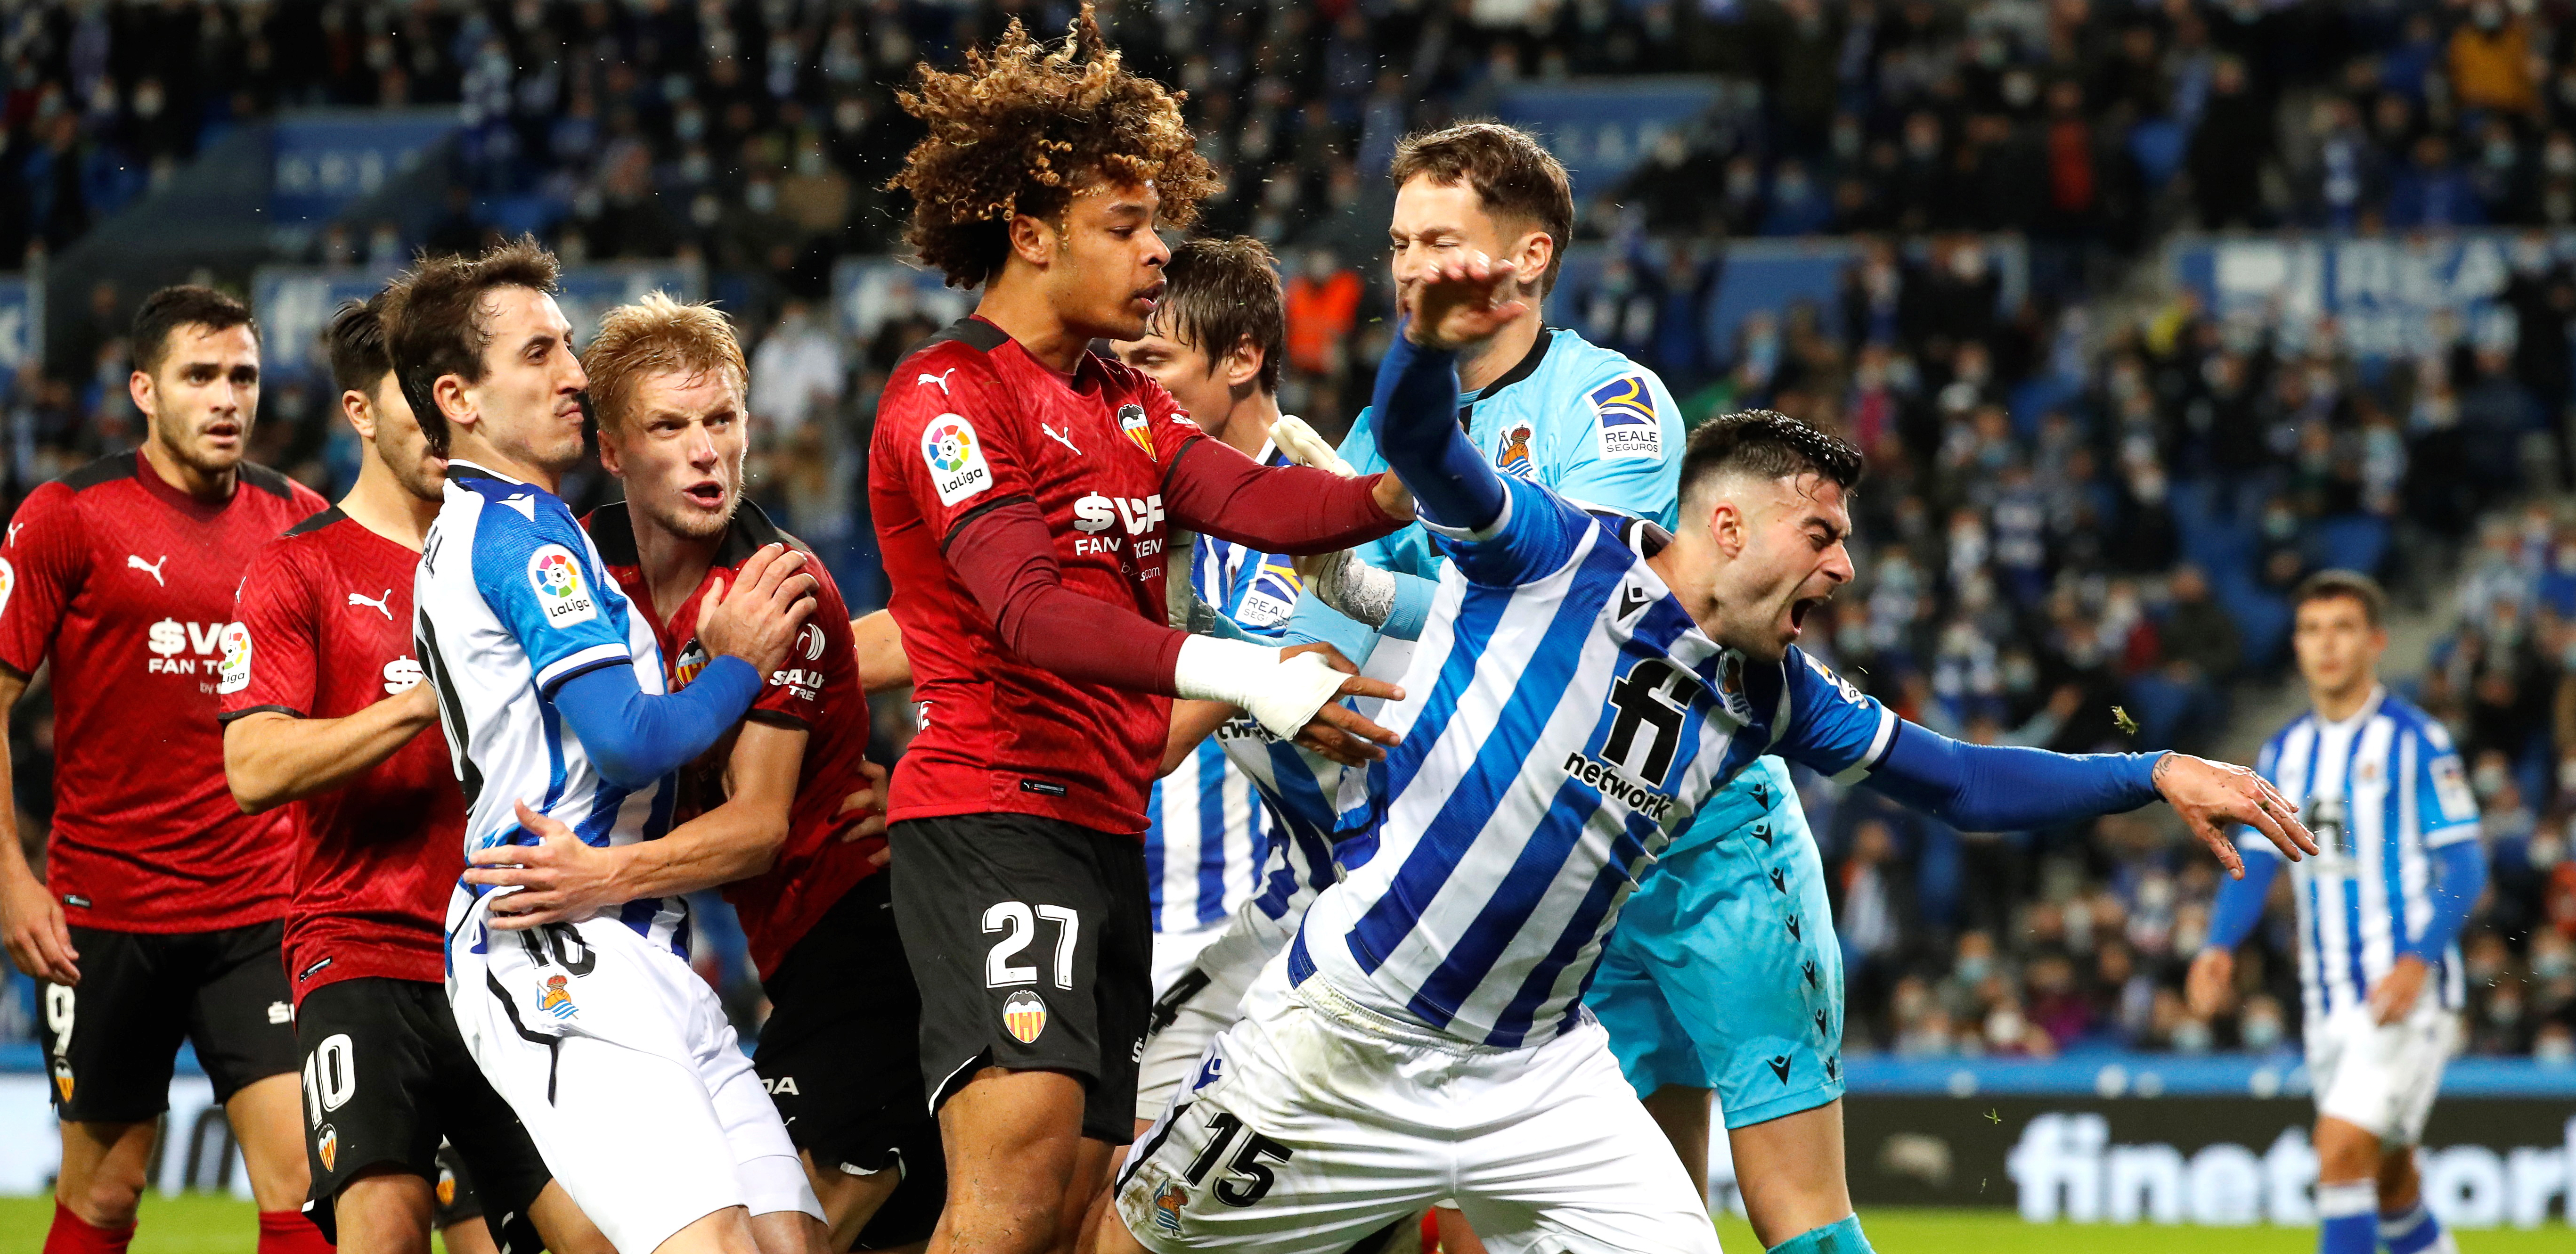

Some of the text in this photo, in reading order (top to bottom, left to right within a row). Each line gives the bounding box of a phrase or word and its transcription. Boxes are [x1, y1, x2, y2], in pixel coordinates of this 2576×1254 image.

[1605, 431, 1657, 443] REALE
[1607, 443, 1658, 452] SEGUROS
[942, 468, 983, 493] LaLiga
[1075, 537, 1162, 559] FAN KEN
[549, 599, 590, 617] LaLiga
[1247, 597, 1290, 622] REAL
[148, 658, 195, 674] FAN
[1563, 752, 1672, 822] network
[981, 901, 1079, 991] 27
[45, 982, 75, 1056] 9
[302, 1033, 356, 1130] 10
[1183, 1112, 1293, 1207] 15
